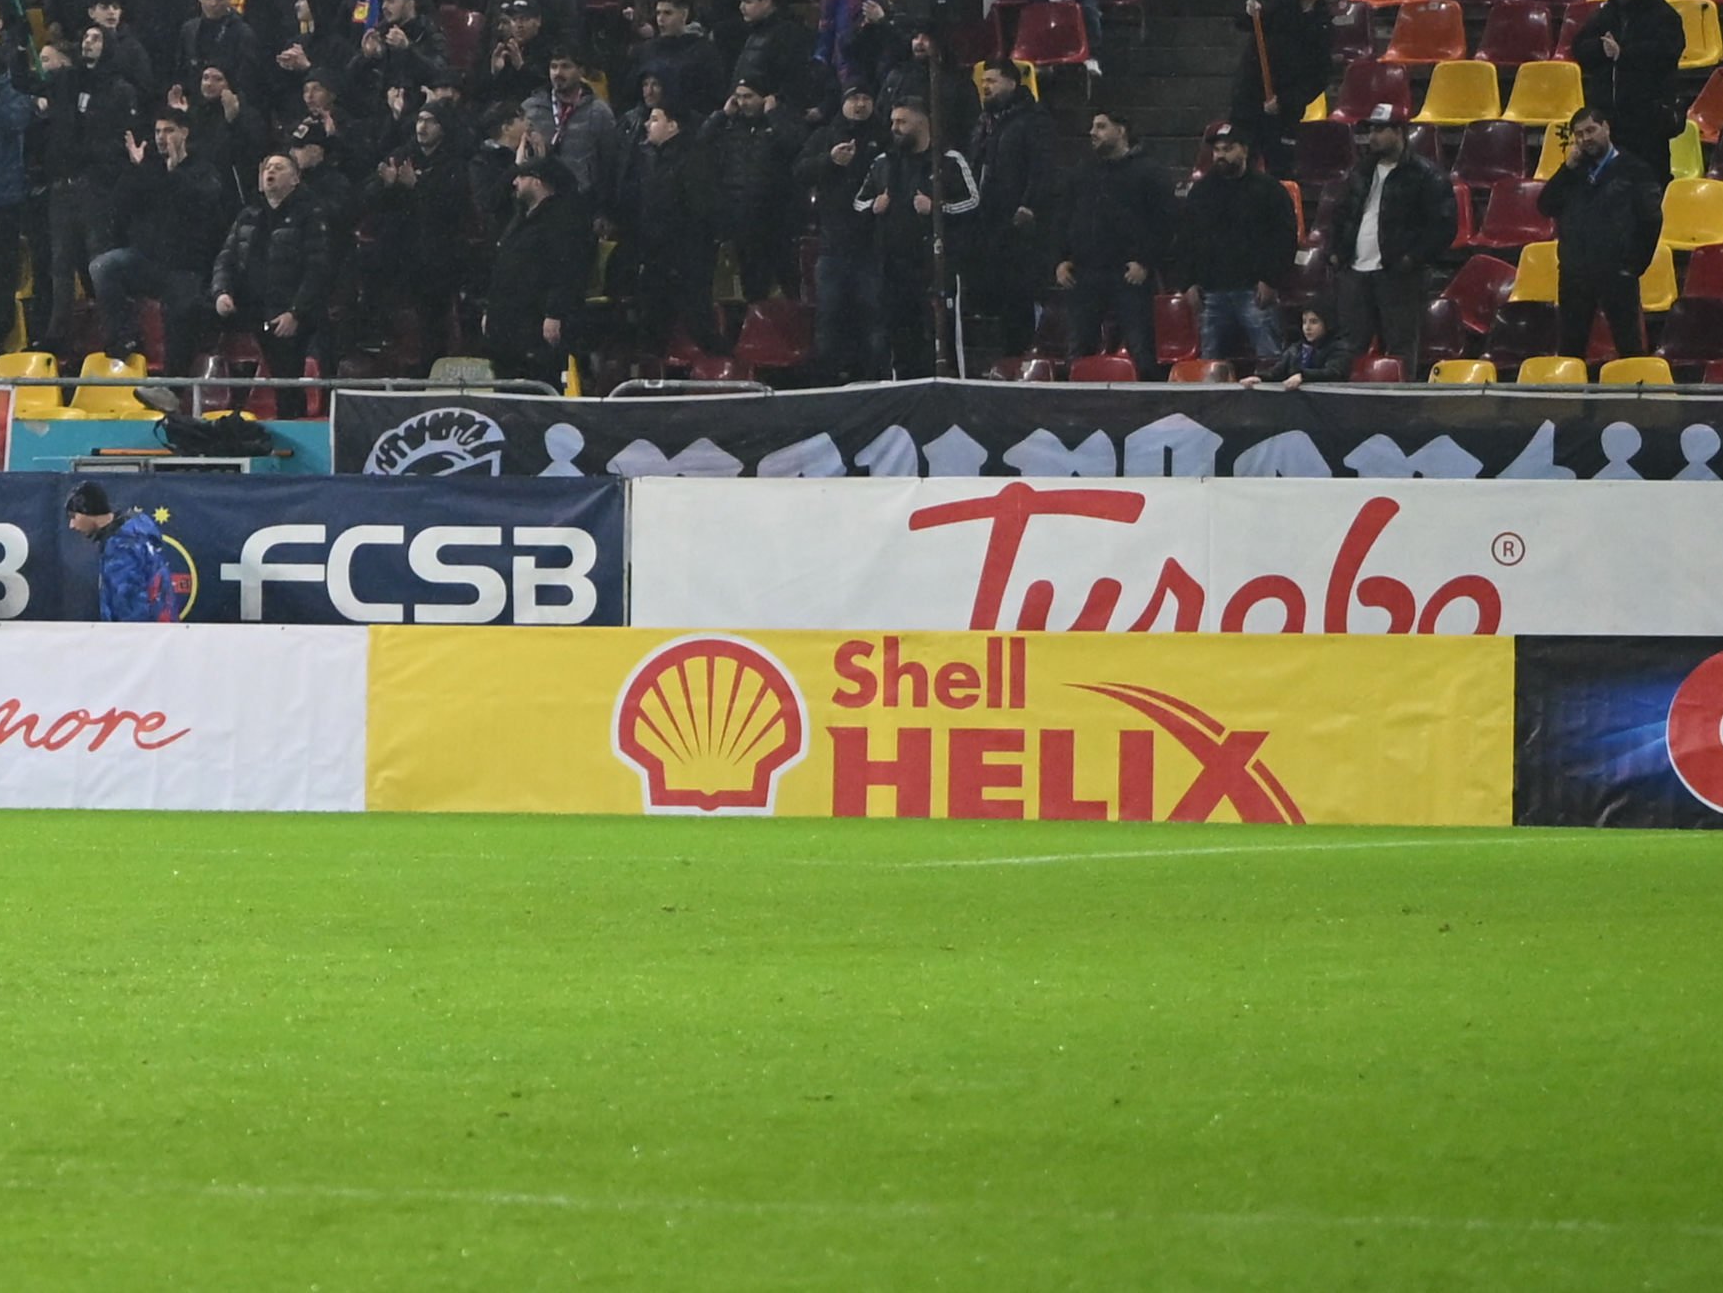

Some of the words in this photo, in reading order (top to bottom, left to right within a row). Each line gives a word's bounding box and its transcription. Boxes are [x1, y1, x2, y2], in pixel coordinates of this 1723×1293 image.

[220, 524, 598, 626] FCSB
[831, 635, 1026, 709] Shell
[825, 687, 1306, 824] HELIX
